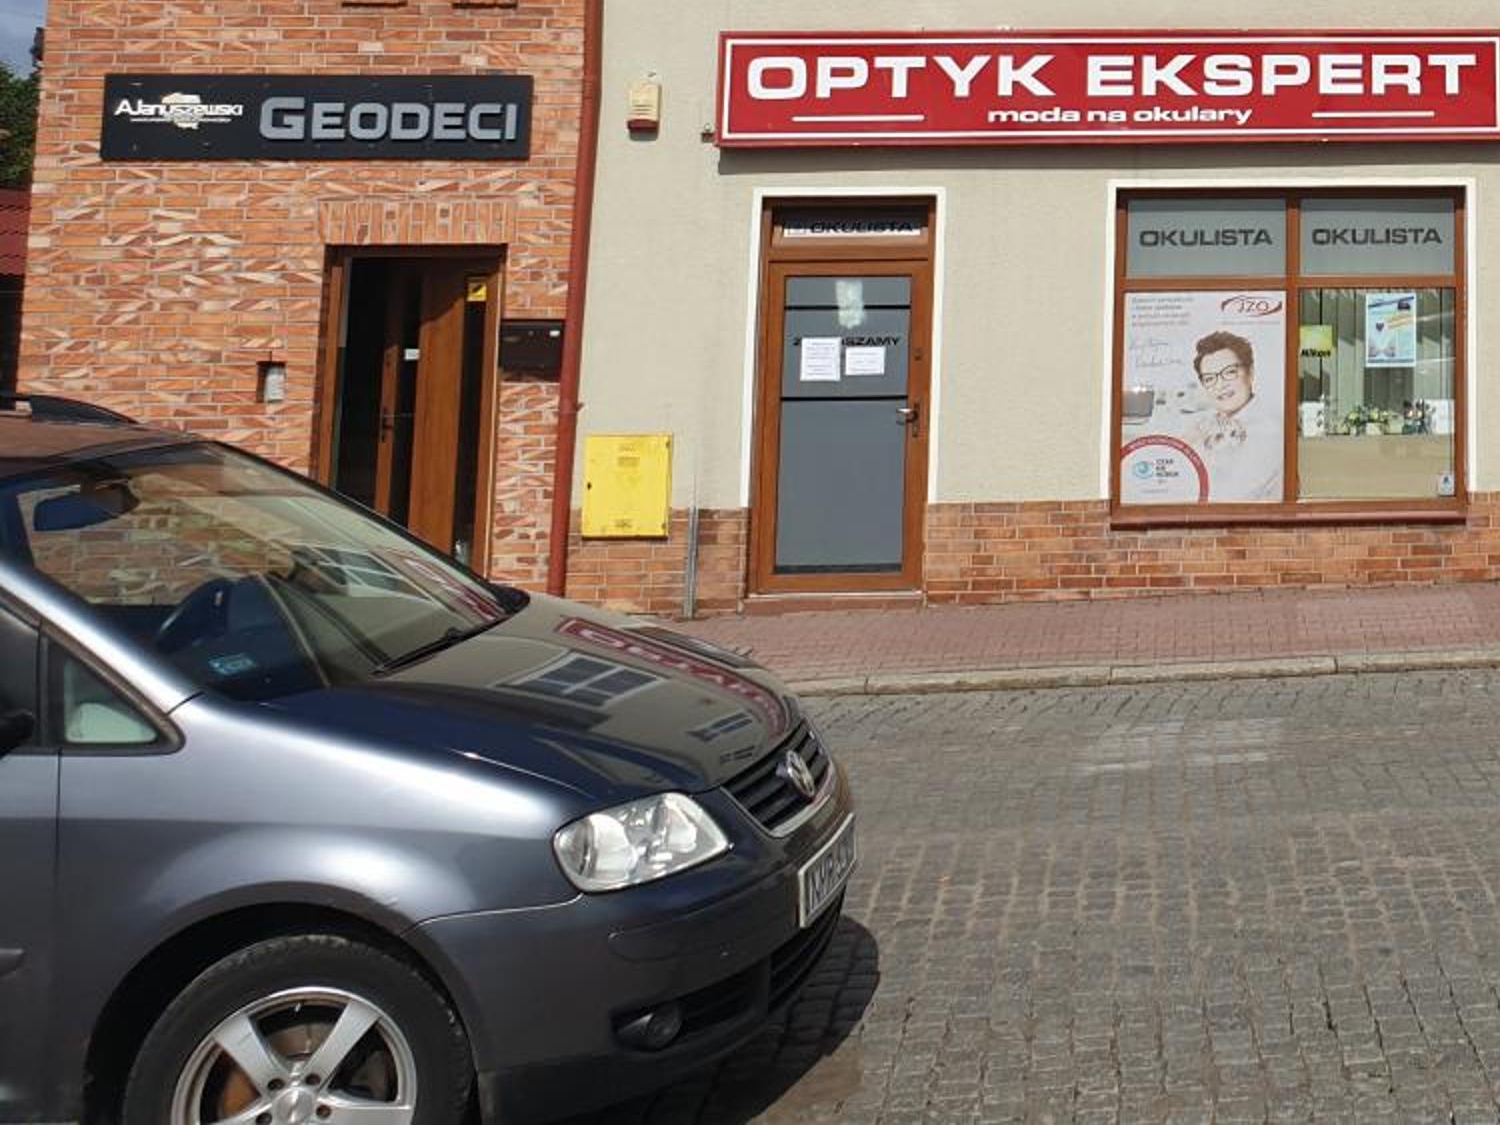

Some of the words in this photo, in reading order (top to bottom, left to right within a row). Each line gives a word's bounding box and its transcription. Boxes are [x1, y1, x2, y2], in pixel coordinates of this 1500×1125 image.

[747, 55, 1056, 100] OPTYK
[1087, 54, 1476, 96] EKSPERT
[259, 97, 517, 141] GEODECI
[988, 108, 1081, 123] moda
[1087, 109, 1128, 123] na
[1133, 107, 1252, 126] okulary
[1139, 228, 1273, 247] OKULISTA
[1311, 228, 1443, 246] OKULISTA
